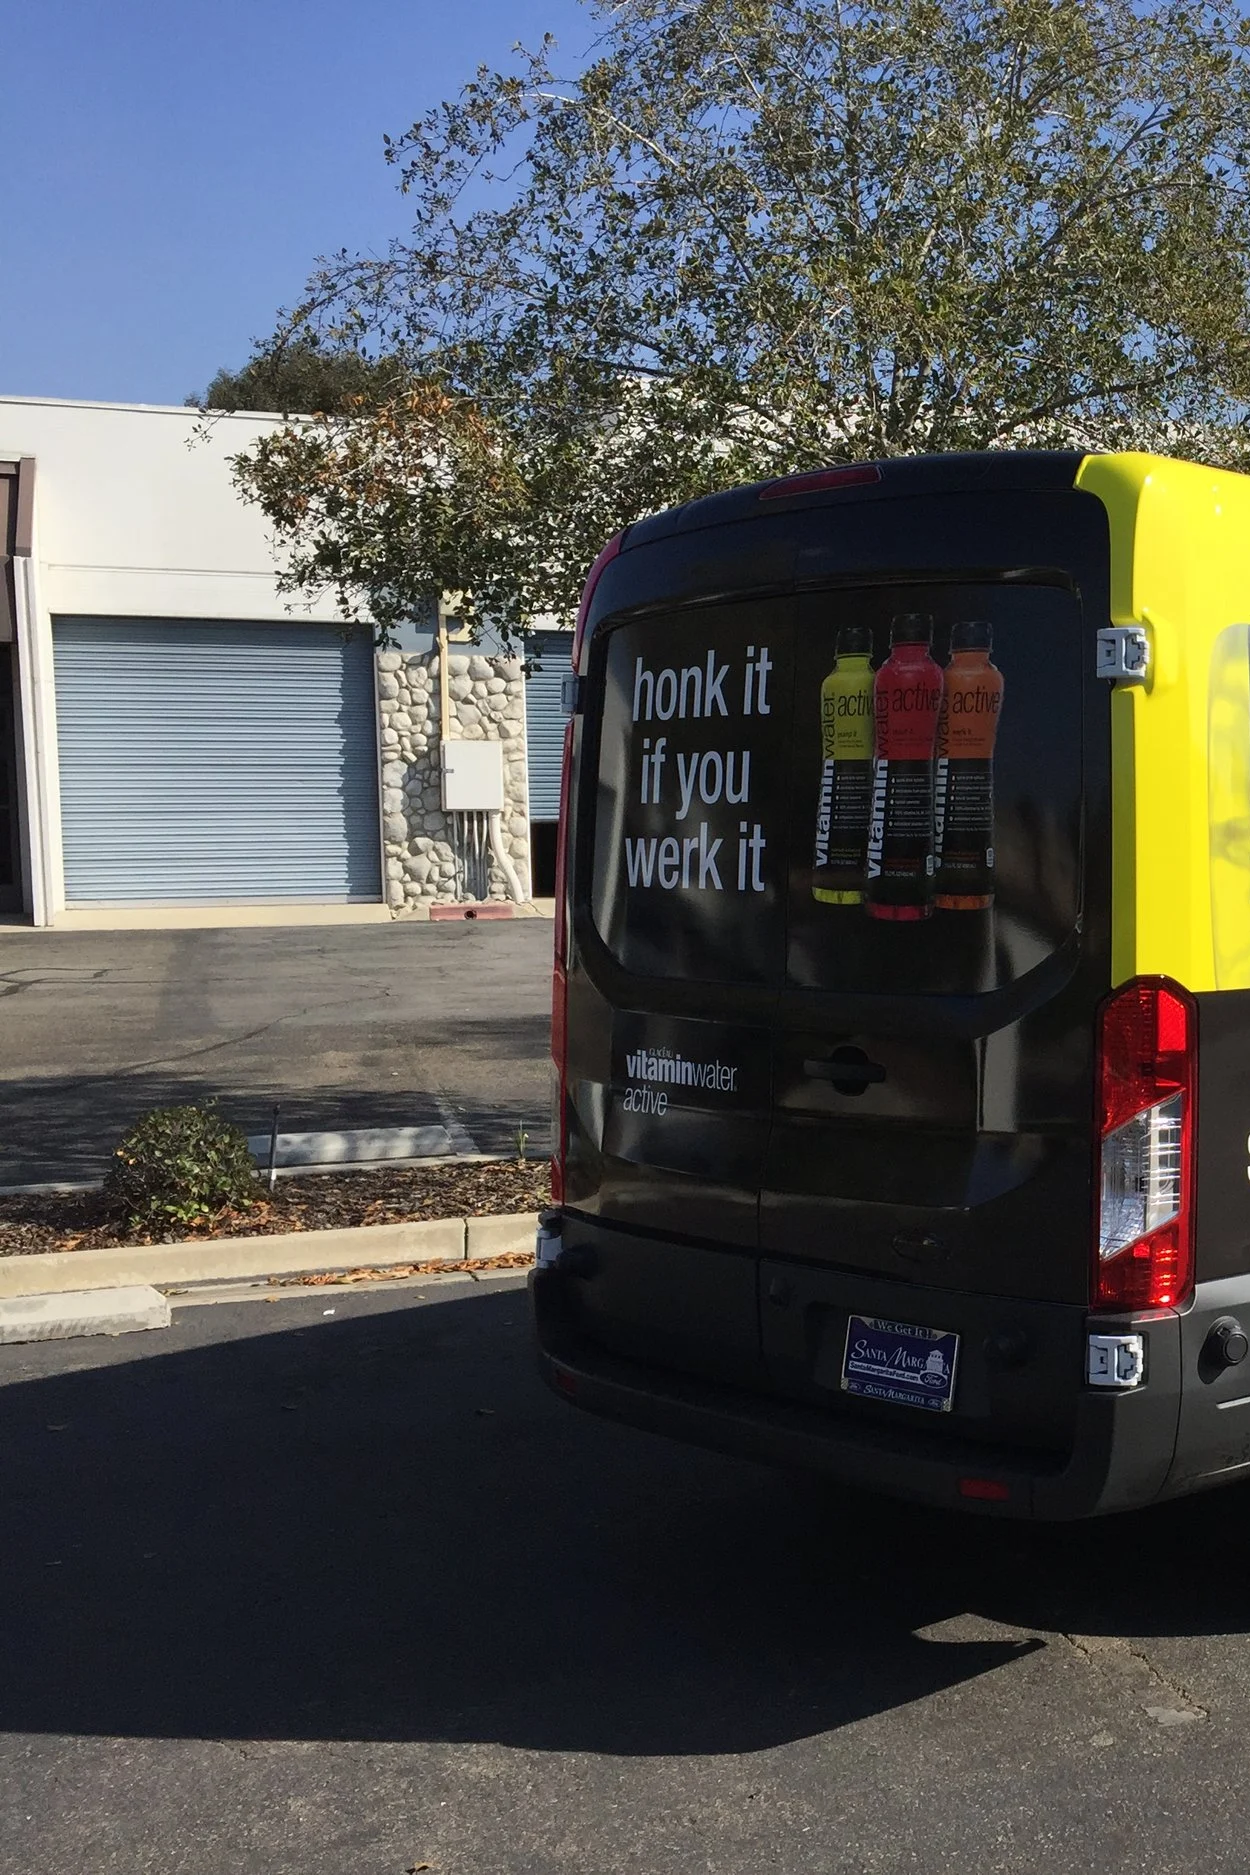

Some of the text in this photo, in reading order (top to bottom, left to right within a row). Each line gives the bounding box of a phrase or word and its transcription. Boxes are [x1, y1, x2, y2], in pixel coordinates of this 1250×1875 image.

[632, 646, 773, 721] honk it
[892, 681, 941, 713] active
[952, 685, 1001, 714] active
[837, 689, 874, 717] activ
[640, 738, 750, 820] if you
[625, 821, 766, 891] werk it
[622, 1084, 668, 1116] active
[876, 1320, 892, 1330] We
[894, 1323, 912, 1336] Get
[850, 1339, 951, 1375] SANTA MARGA
[924, 1373, 943, 1386] Ford
